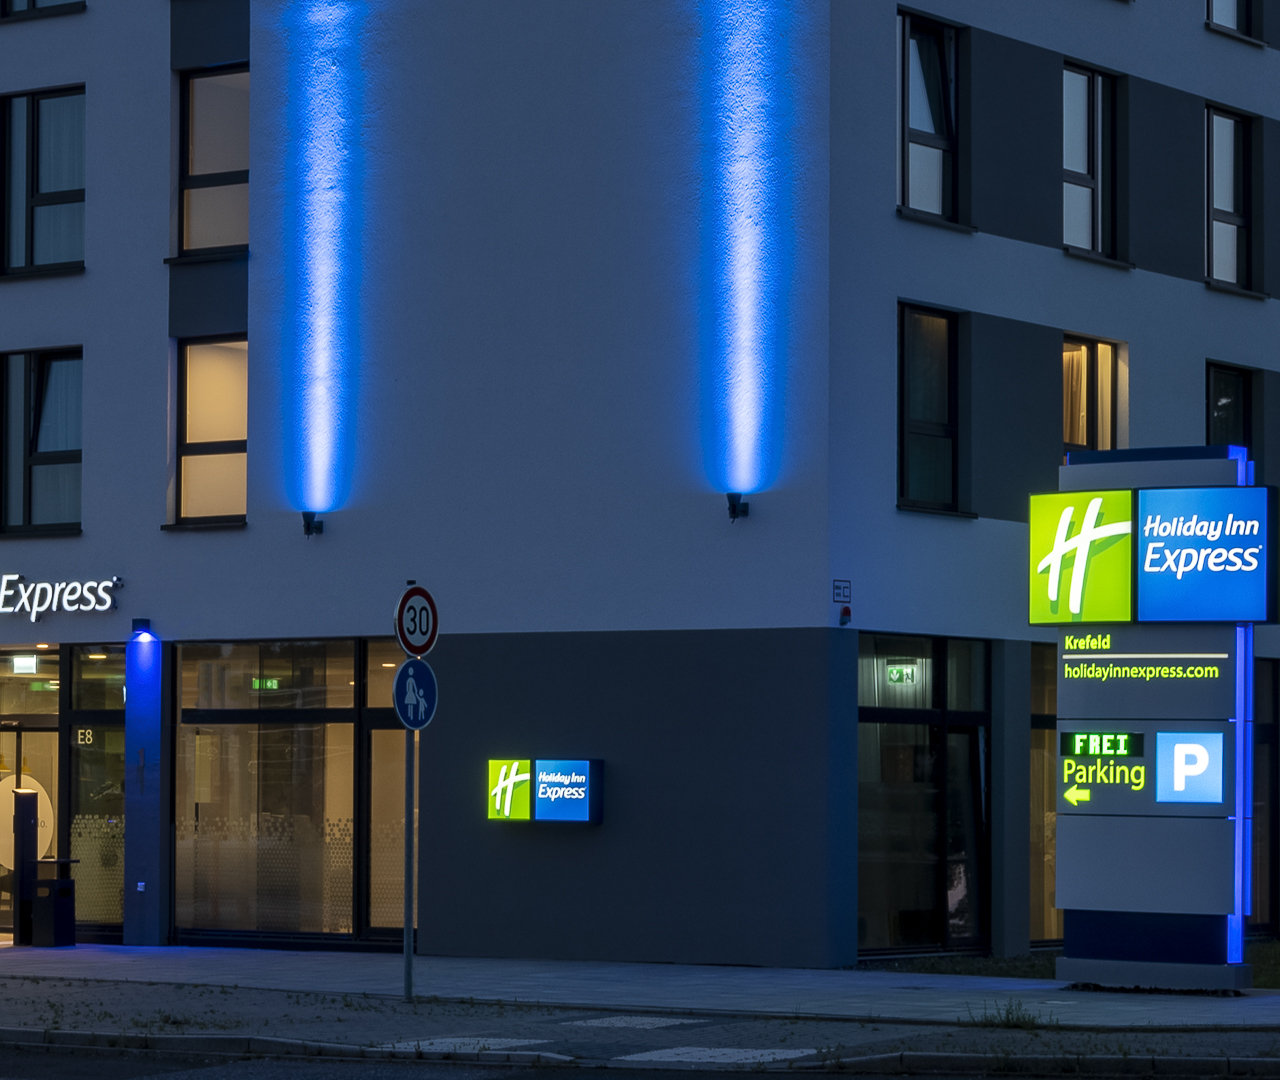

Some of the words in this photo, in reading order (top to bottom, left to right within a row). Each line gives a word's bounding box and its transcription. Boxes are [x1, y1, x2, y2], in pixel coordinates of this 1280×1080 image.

[1143, 514, 1222, 542] Holiday
[1224, 513, 1260, 536] Inn
[1143, 541, 1260, 581] Express
[405, 605, 430, 636] 30
[1064, 634, 1111, 650] Krefeld
[1063, 663, 1220, 682] holidayinnexpress.com
[76, 729, 94, 745] E8
[1074, 734, 1129, 756] FREI
[538, 771, 571, 786] Holiday
[571, 772, 586, 783] Inn
[1063, 758, 1146, 791] Parking
[1173, 743, 1210, 792] P
[538, 783, 586, 802] Express
